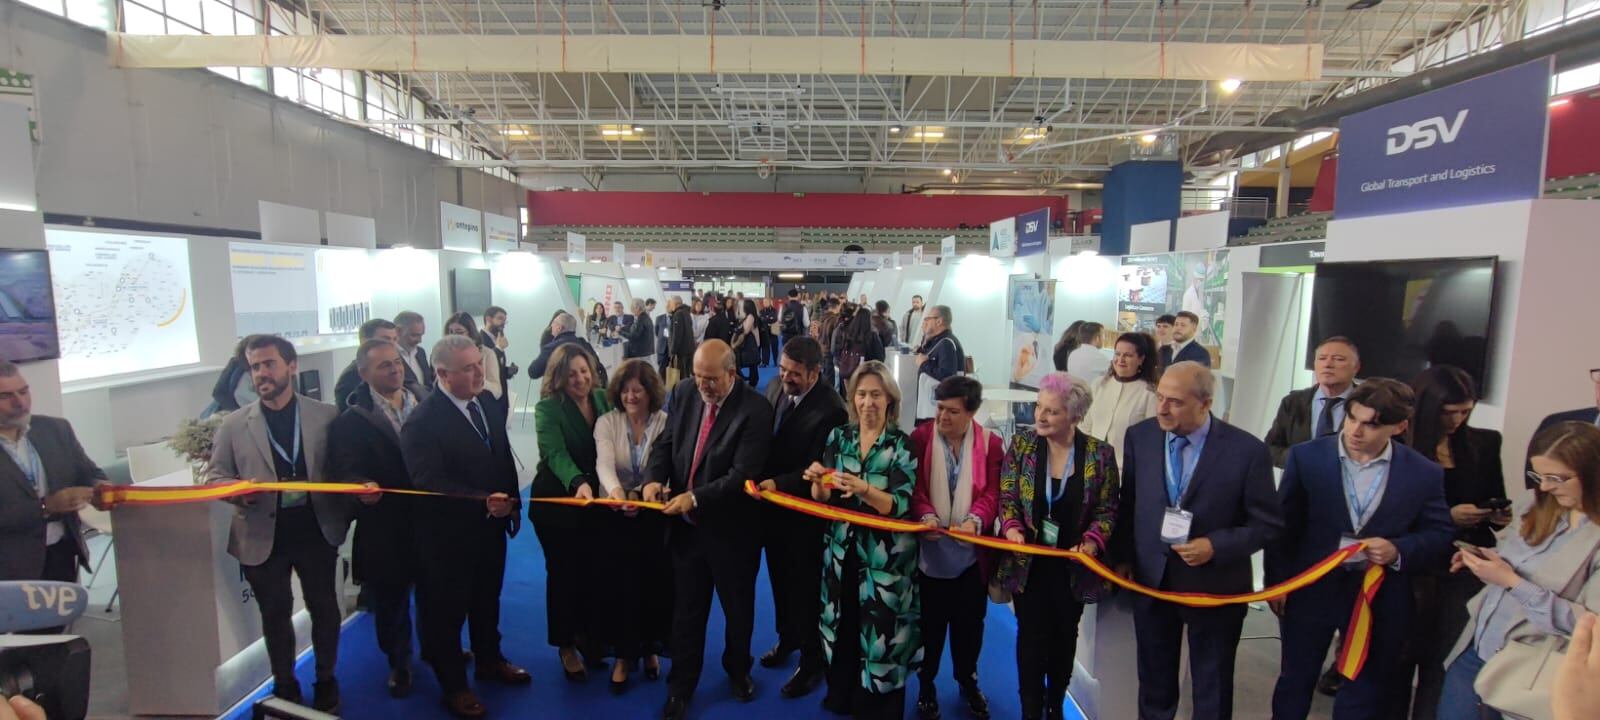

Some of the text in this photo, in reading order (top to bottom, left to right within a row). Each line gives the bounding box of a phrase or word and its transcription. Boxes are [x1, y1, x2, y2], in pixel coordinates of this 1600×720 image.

[1386, 109, 1470, 156] DSV
[1361, 163, 1496, 193] Global Transport and Logistics
[1025, 220, 1039, 234] DSV
[21, 583, 77, 616] tve
